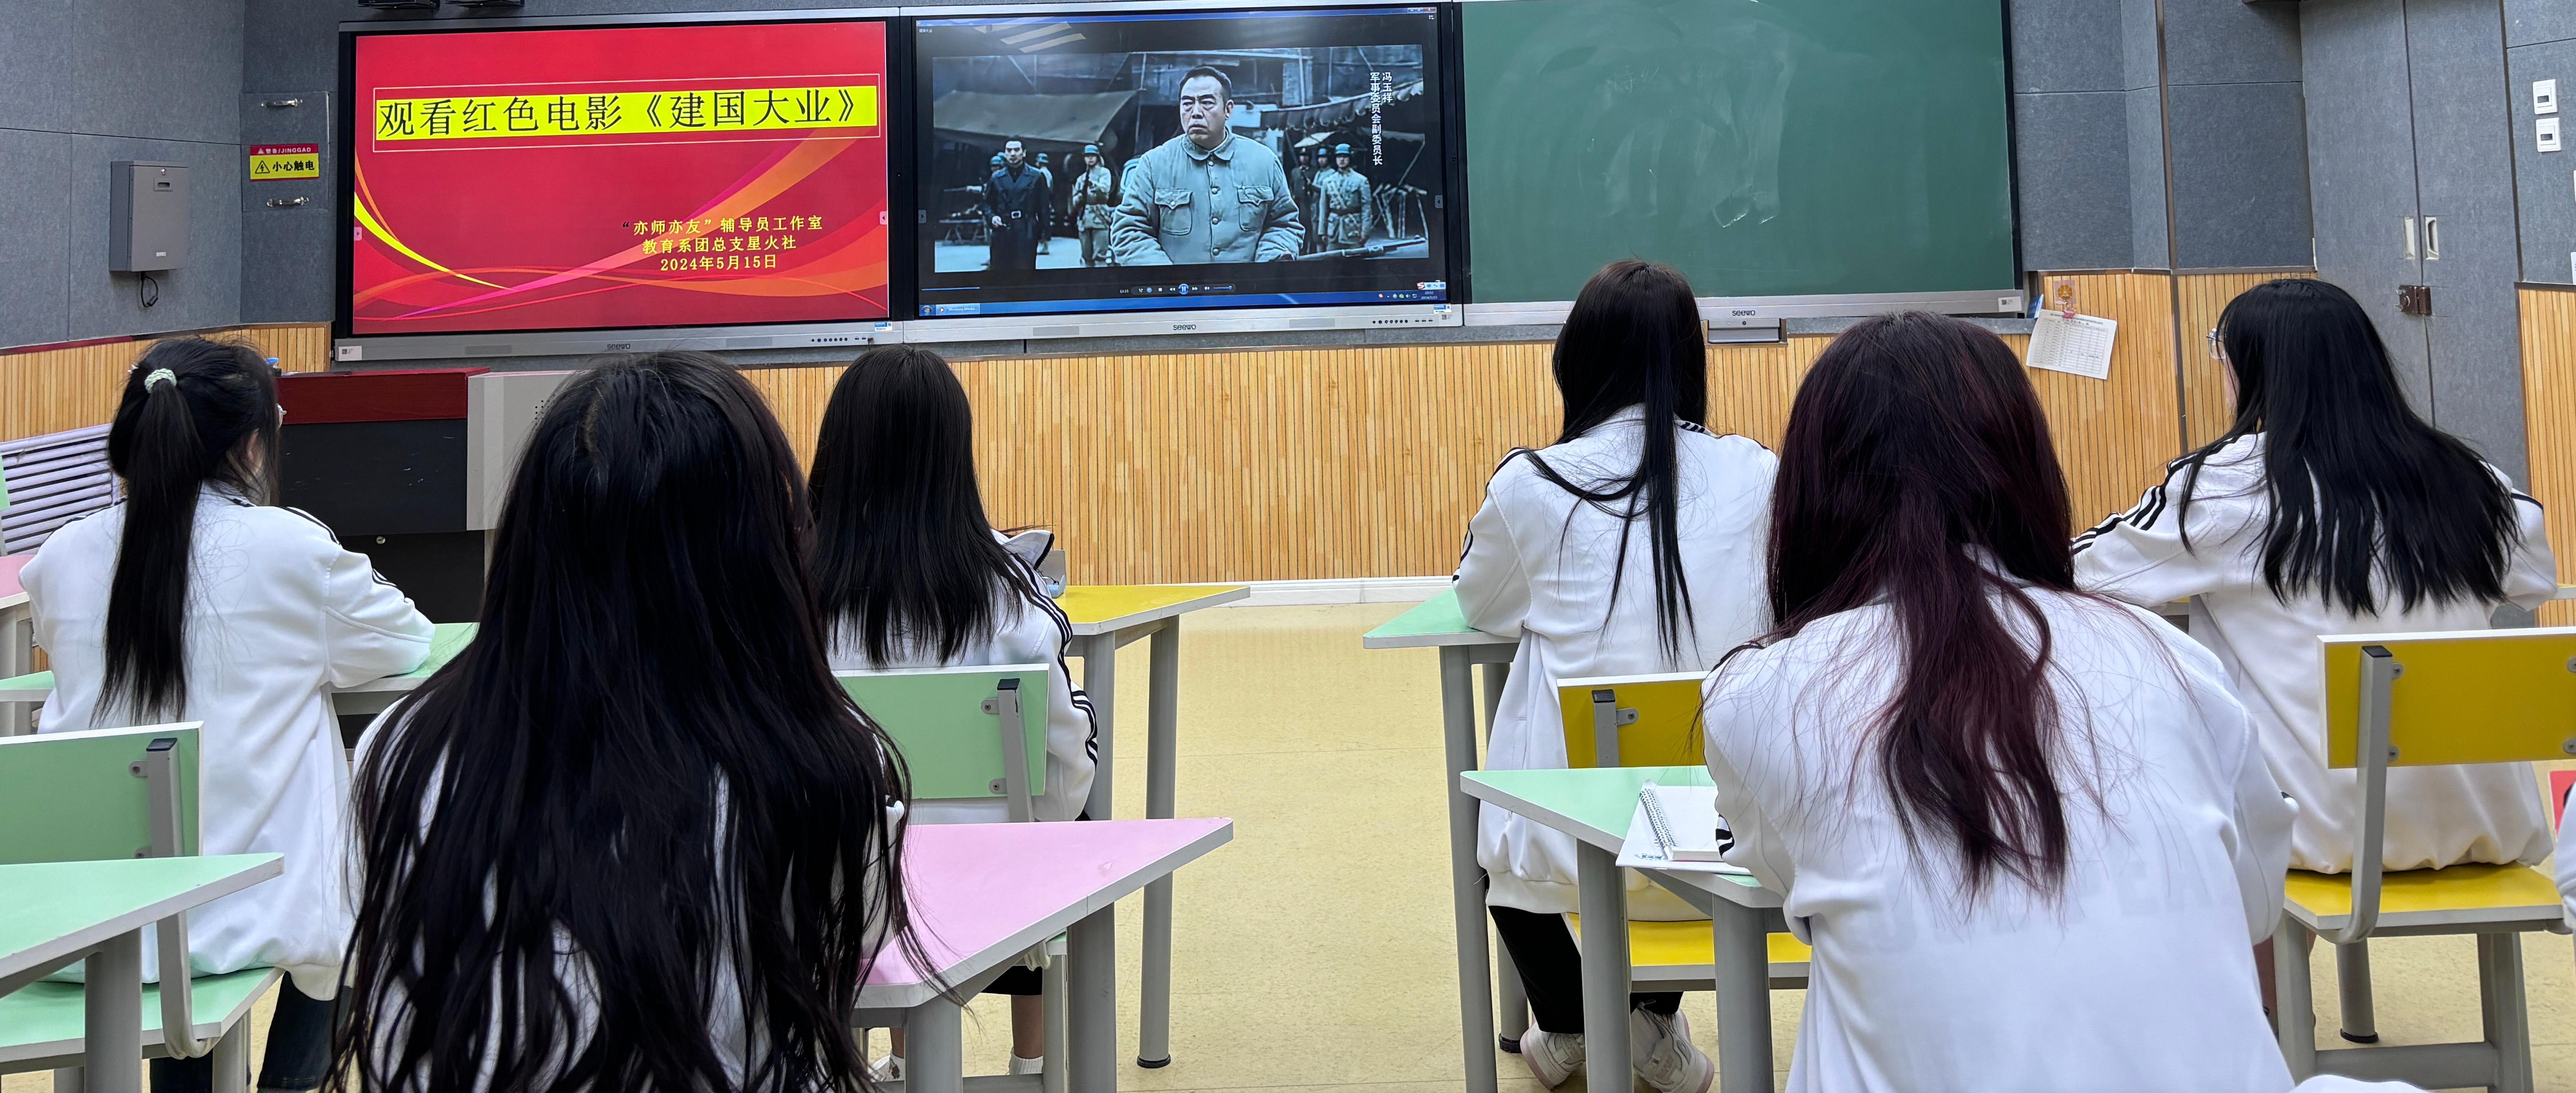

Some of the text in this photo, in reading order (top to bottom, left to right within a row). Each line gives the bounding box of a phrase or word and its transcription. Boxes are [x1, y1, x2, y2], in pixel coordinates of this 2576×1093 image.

[1382, 72, 1393, 103] 冯玉祥
[378, 89, 854, 137] 观看红色电影《建国大业》
[1370, 72, 1382, 165] 军事委员会副委员长
[272, 160, 315, 171] 小心触电
[622, 216, 823, 235] “亦师亦友”辅导员工作室
[642, 235, 796, 254] 教育系团总支星火社
[661, 254, 777, 271] 2024年5月15日
